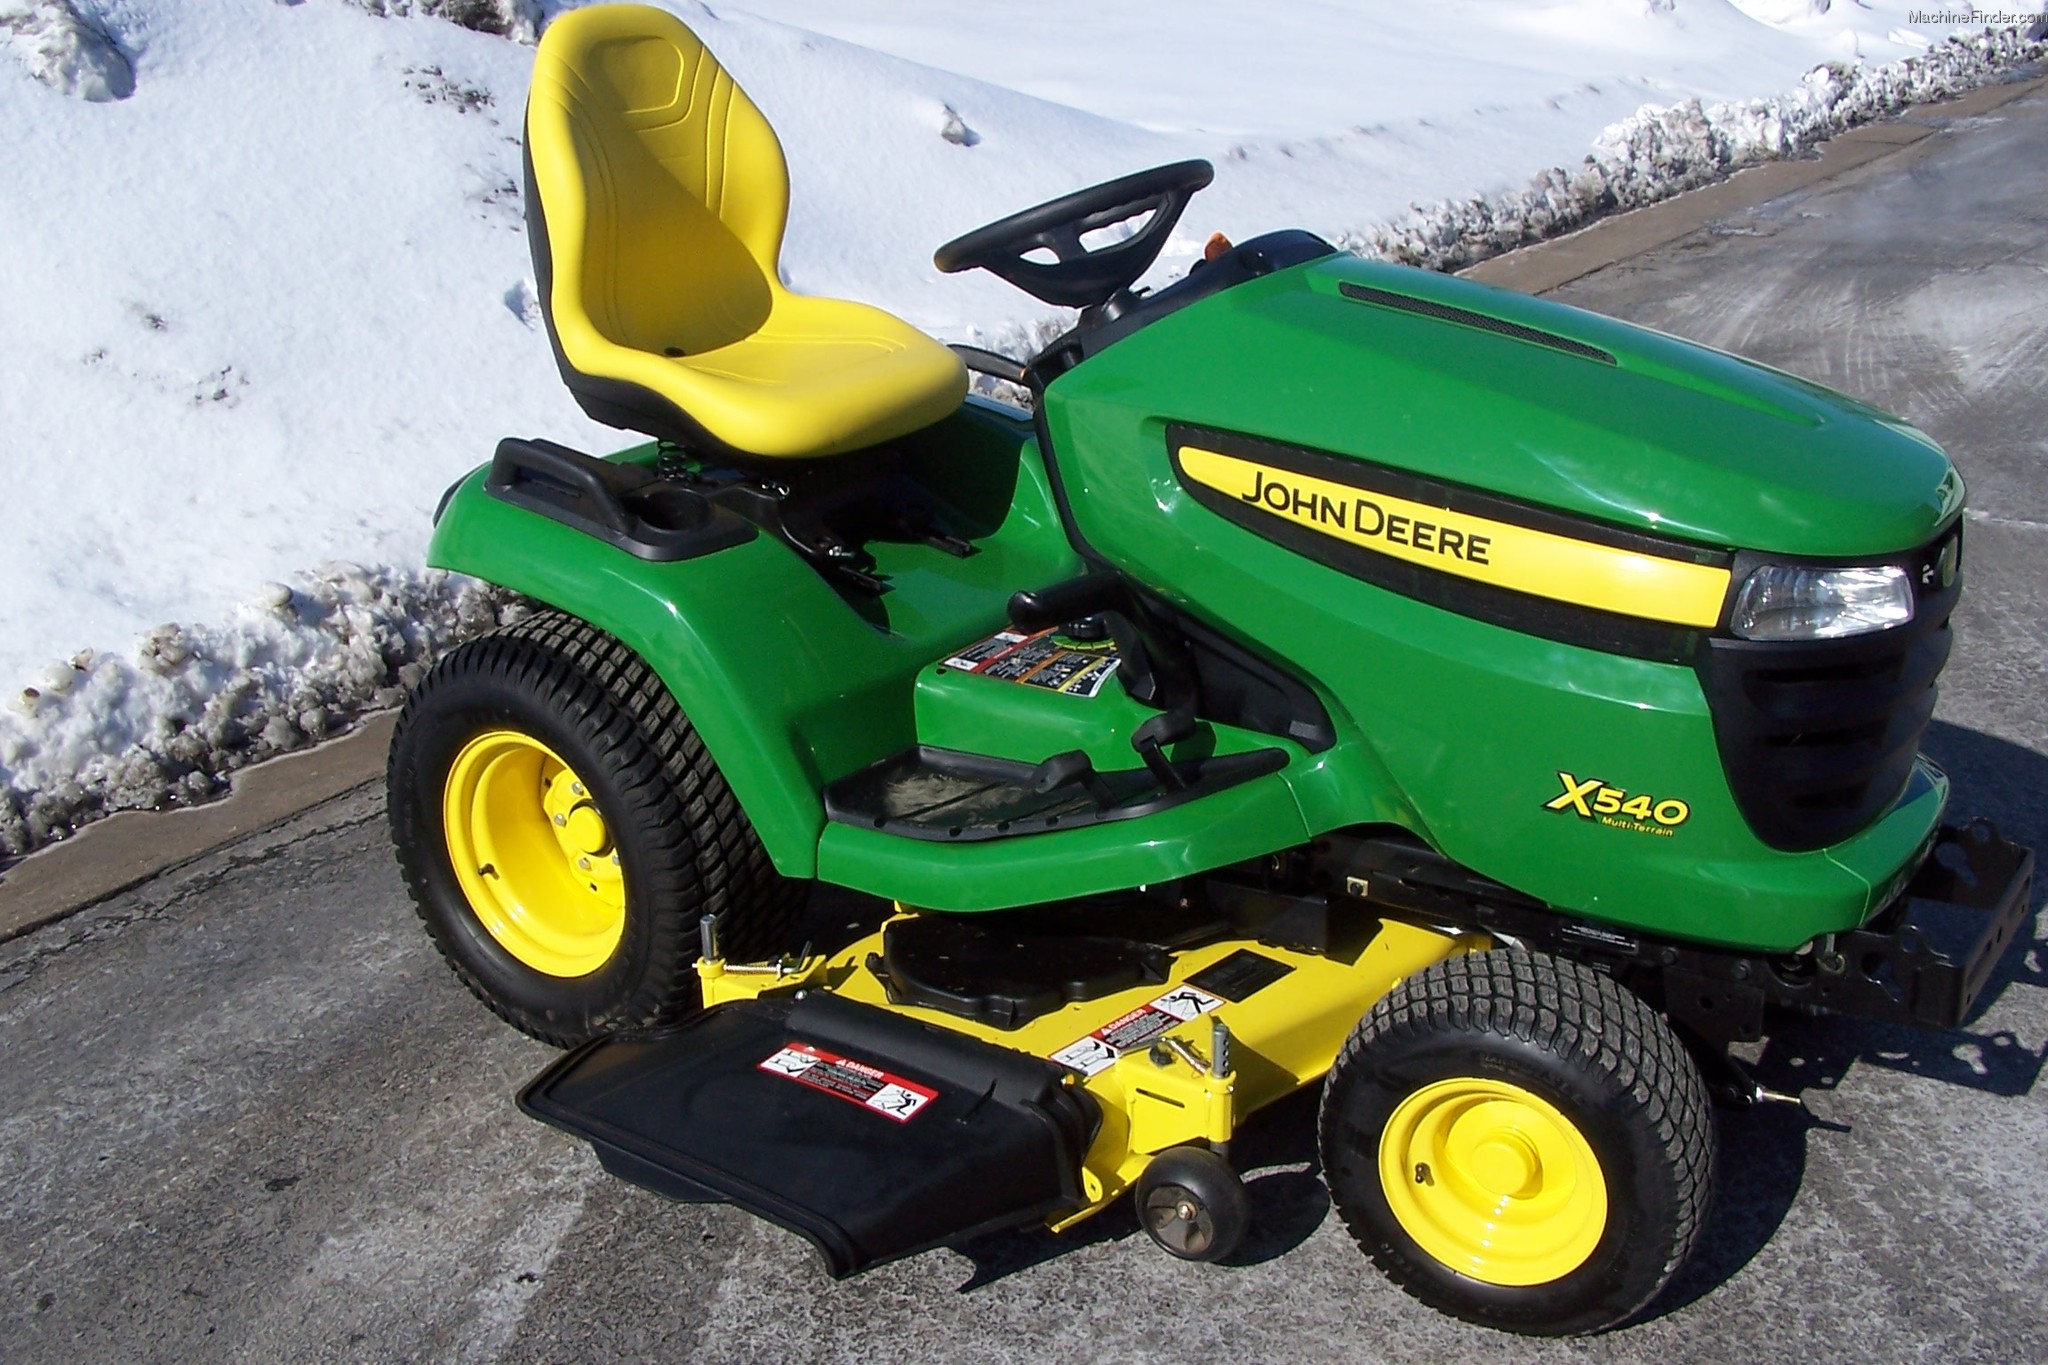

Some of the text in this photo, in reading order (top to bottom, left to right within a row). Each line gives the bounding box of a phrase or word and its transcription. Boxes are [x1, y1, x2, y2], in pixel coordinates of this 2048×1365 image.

[1241, 471, 1492, 566] JOHN DEERE
[1543, 771, 1690, 826] X540
[1108, 1008, 1147, 1030] DANGER
[845, 1060, 885, 1079] DANGER
